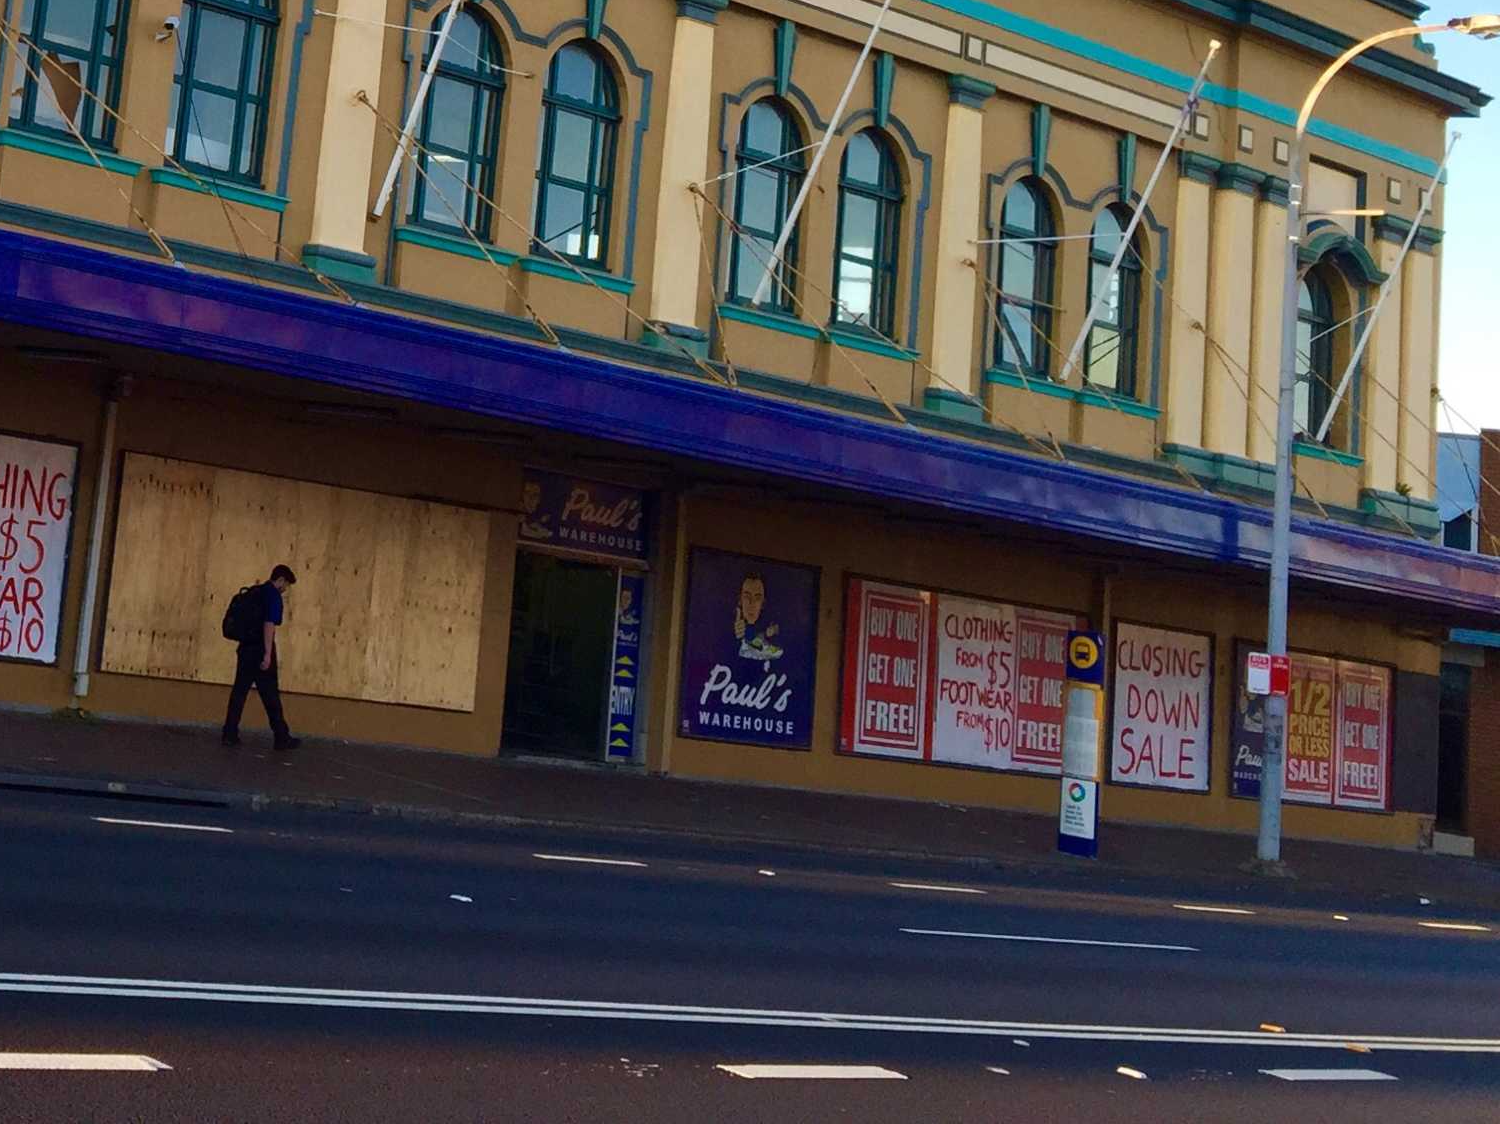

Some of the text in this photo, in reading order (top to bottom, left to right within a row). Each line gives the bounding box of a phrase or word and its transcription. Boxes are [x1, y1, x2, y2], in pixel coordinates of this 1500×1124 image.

[561, 487, 644, 533] Paul's
[557, 527, 644, 552] WAREHOUSE
[870, 606, 918, 643] BUY ONE
[944, 613, 1013, 644] CLOTHING
[1019, 628, 1065, 665] BUY ONE
[1117, 639, 1205, 679] CLOSING
[867, 652, 917, 689] GET ONE
[956, 645, 1012, 689] FROM $5
[611, 684, 636, 717] ENTRY
[699, 663, 793, 713] Paul's
[940, 678, 1015, 714] FOOTWEAR
[1019, 672, 1063, 709] GET ONE
[1291, 679, 1331, 716] 1/2
[698, 710, 795, 735] WAREHOUSE
[865, 699, 915, 735] FREE!
[1127, 683, 1200, 731] DOWN
[956, 710, 1011, 753] FROM $10
[1016, 717, 1062, 753] FREE!
[1289, 714, 1330, 738] PRICE
[1344, 720, 1361, 748] GET
[1117, 727, 1195, 780] SALE
[1289, 734, 1331, 758] OR LESS
[1288, 758, 1329, 785] SALE
[1342, 759, 1379, 790] FREE!
